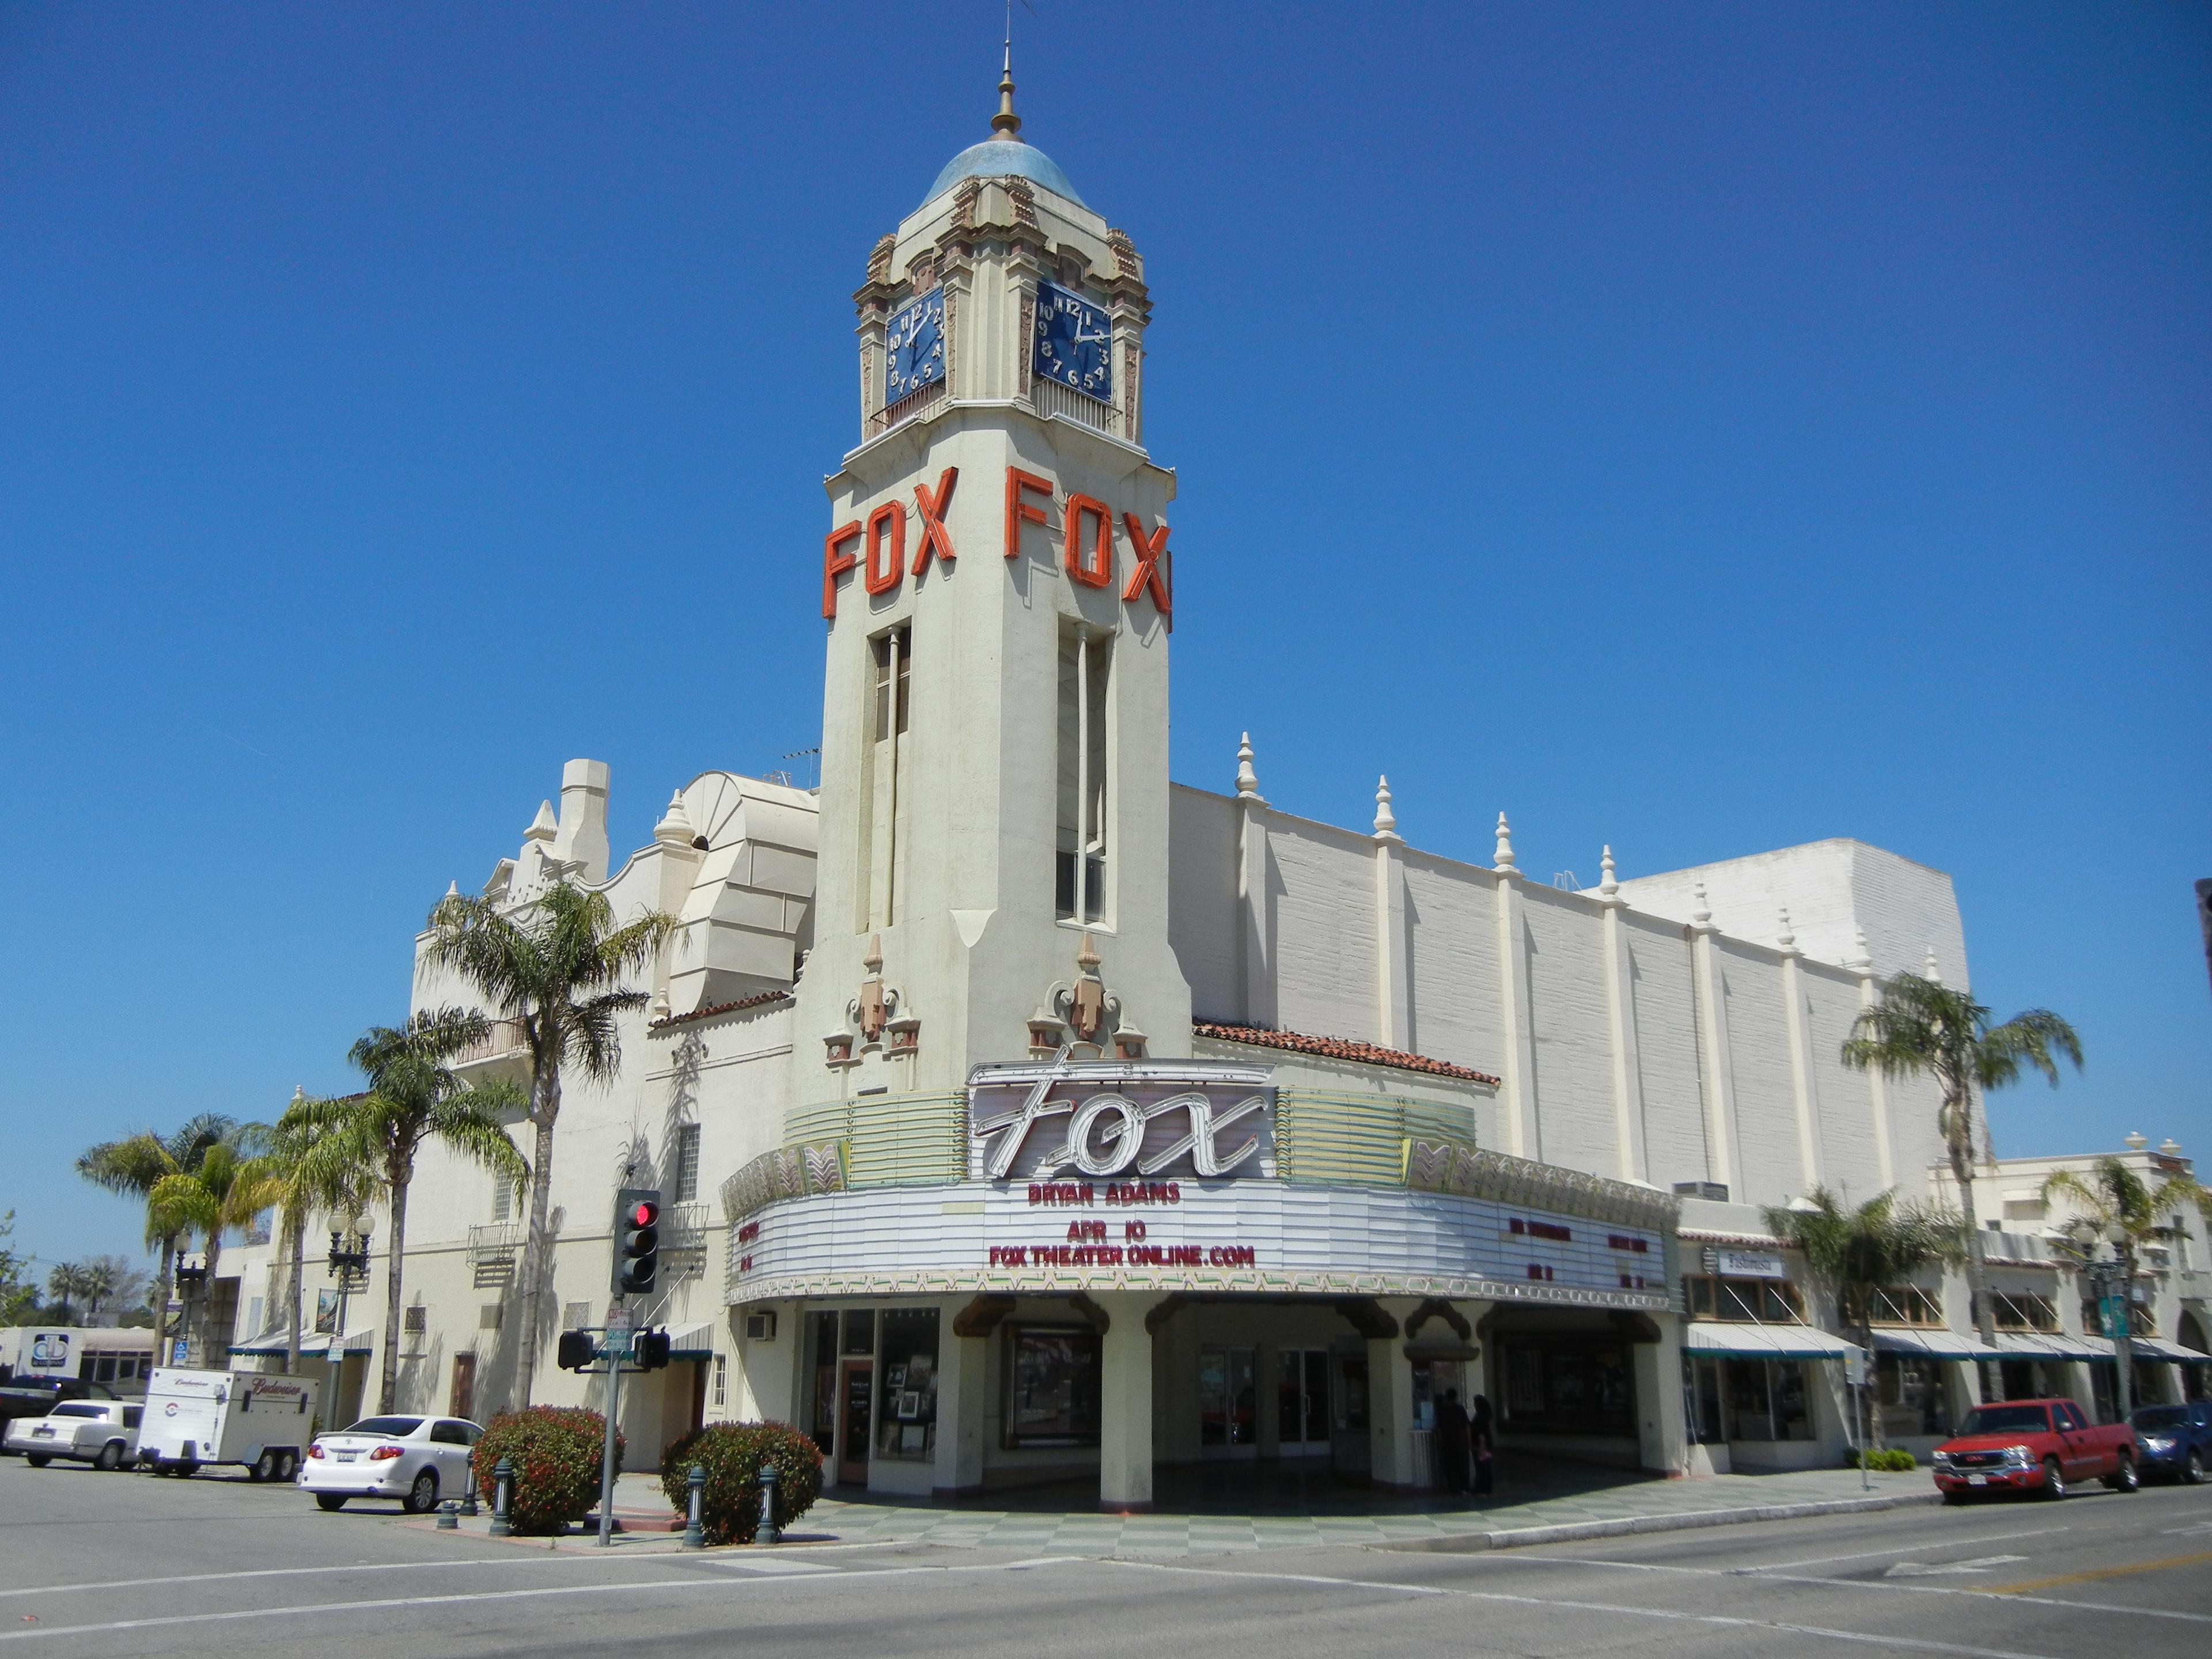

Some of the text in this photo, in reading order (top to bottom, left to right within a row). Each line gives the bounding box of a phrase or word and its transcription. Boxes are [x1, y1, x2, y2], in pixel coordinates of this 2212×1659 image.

[1039, 302, 1054, 321] 10
[1054, 295, 1063, 313] 11
[1066, 298, 1081, 317] 12
[902, 315, 908, 332] 11
[933, 308, 941, 324] 2
[1086, 311, 1091, 326] 1
[937, 323, 944, 339] 3
[1038, 321, 1048, 336] 9
[890, 334, 901, 351] 10
[1094, 329, 1104, 345] 2
[932, 343, 941, 359] 4
[1041, 341, 1052, 357] 8
[1099, 348, 1109, 365] 3
[889, 355, 896, 370] 9
[924, 363, 932, 378] 5
[1053, 359, 1062, 374] 7
[891, 370, 899, 387] 8
[911, 374, 919, 389] 6
[1068, 370, 1078, 385] 6
[1084, 374, 1094, 389] 5
[1094, 366, 1104, 381] 4
[899, 377, 907, 396] 7
[823, 467, 959, 619] FOX
[1004, 465, 1172, 615] FOX
[1028, 1183, 1180, 1204] BRYAN ADAMS
[1067, 1220, 1146, 1241] APR 10
[252, 1377, 301, 1395] Budweiser
